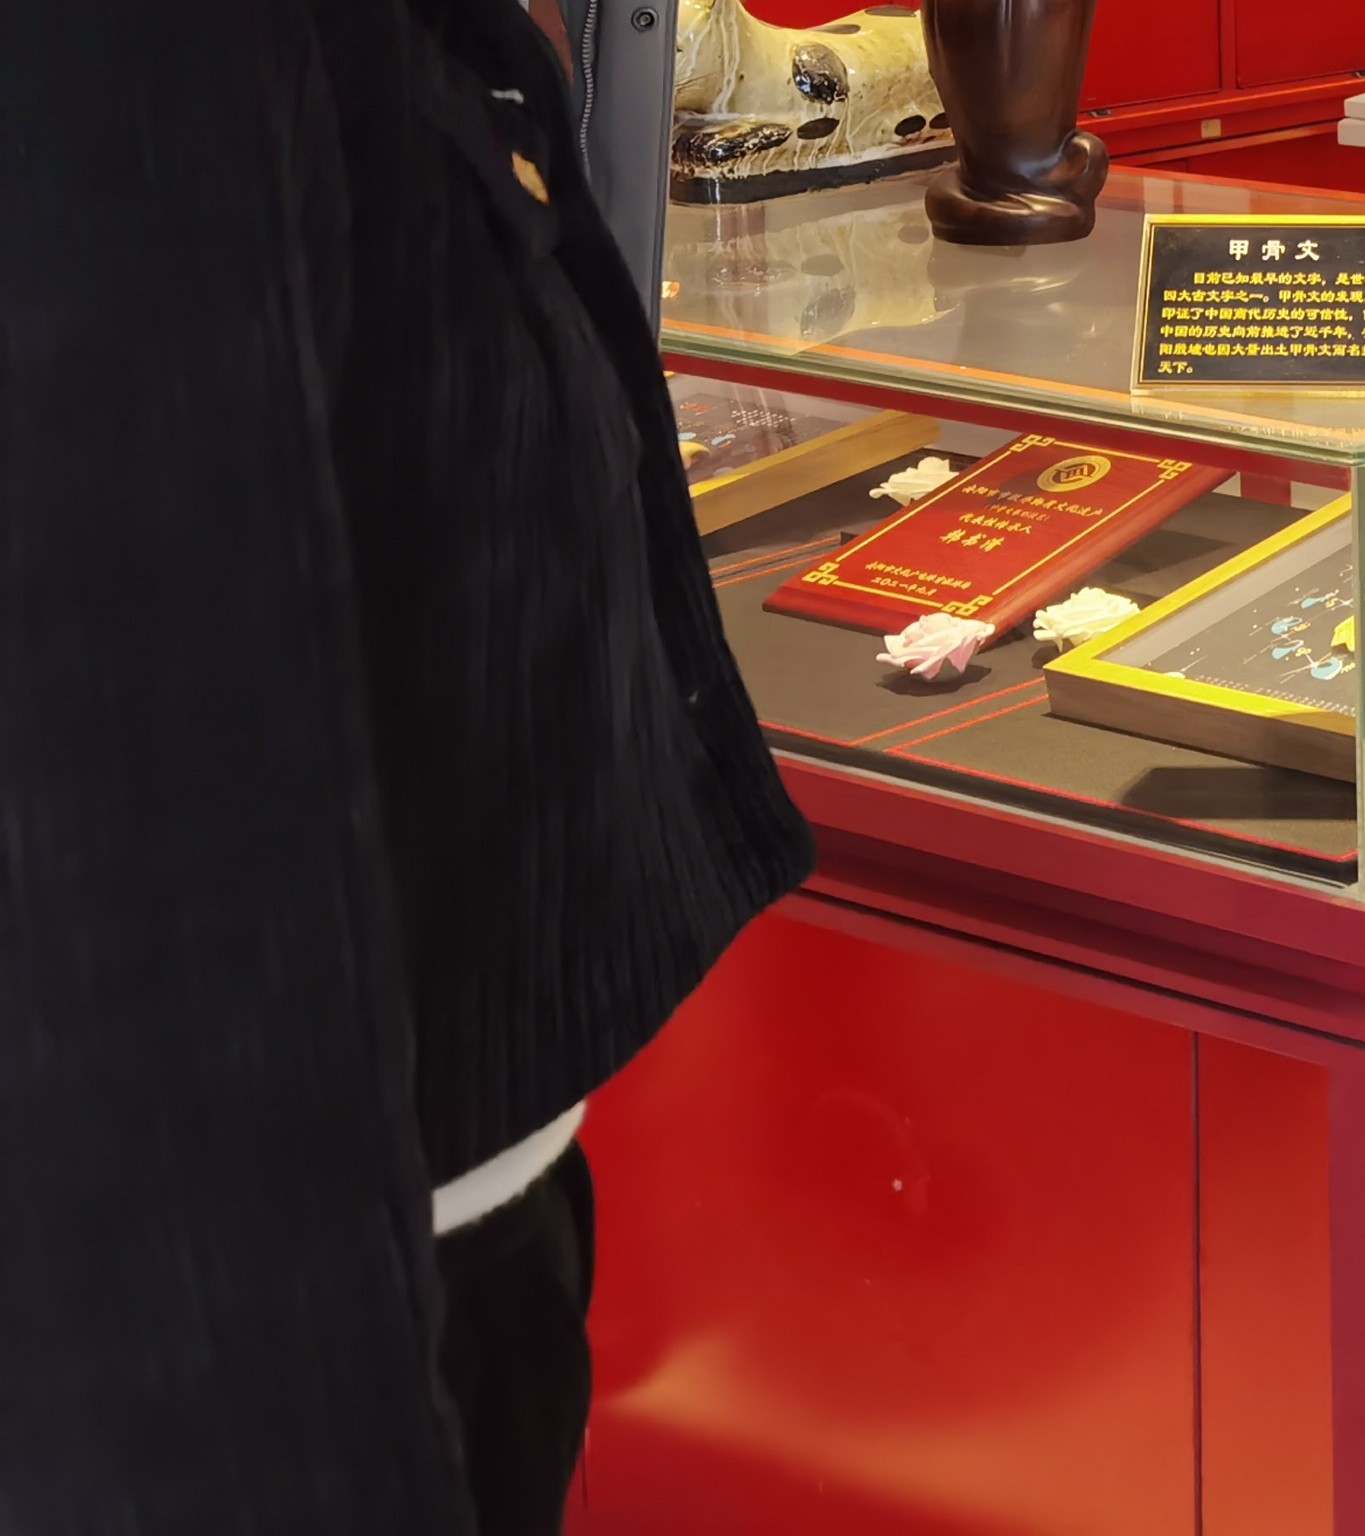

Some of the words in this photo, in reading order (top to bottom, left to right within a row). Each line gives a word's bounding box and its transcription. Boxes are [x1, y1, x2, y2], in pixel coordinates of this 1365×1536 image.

[1229, 239, 1320, 261] 甲骨文
[1157, 360, 1194, 375] 天下。
